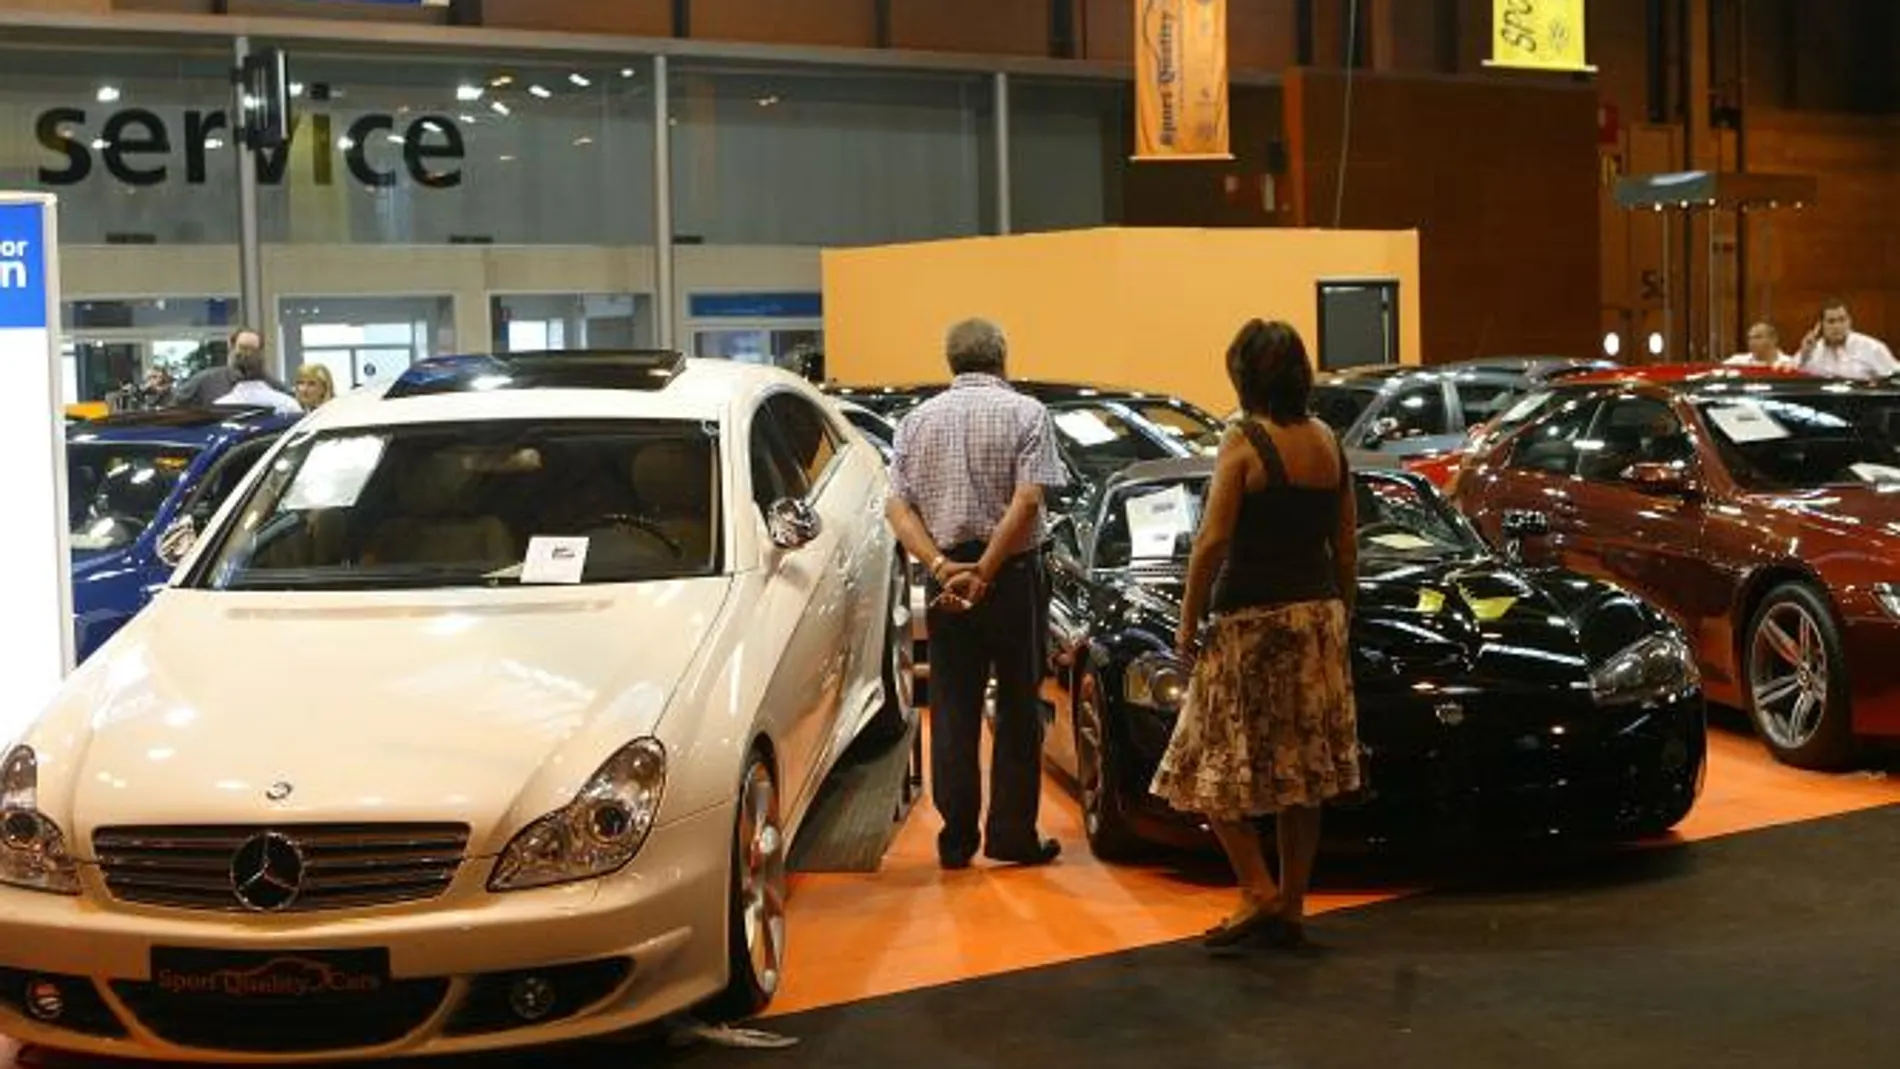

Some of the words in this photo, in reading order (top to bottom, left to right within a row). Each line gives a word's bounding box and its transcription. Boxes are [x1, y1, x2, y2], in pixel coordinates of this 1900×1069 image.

[0, 240, 28, 257] or
[157, 968, 216, 994] Sport
[223, 967, 310, 997] Quality
